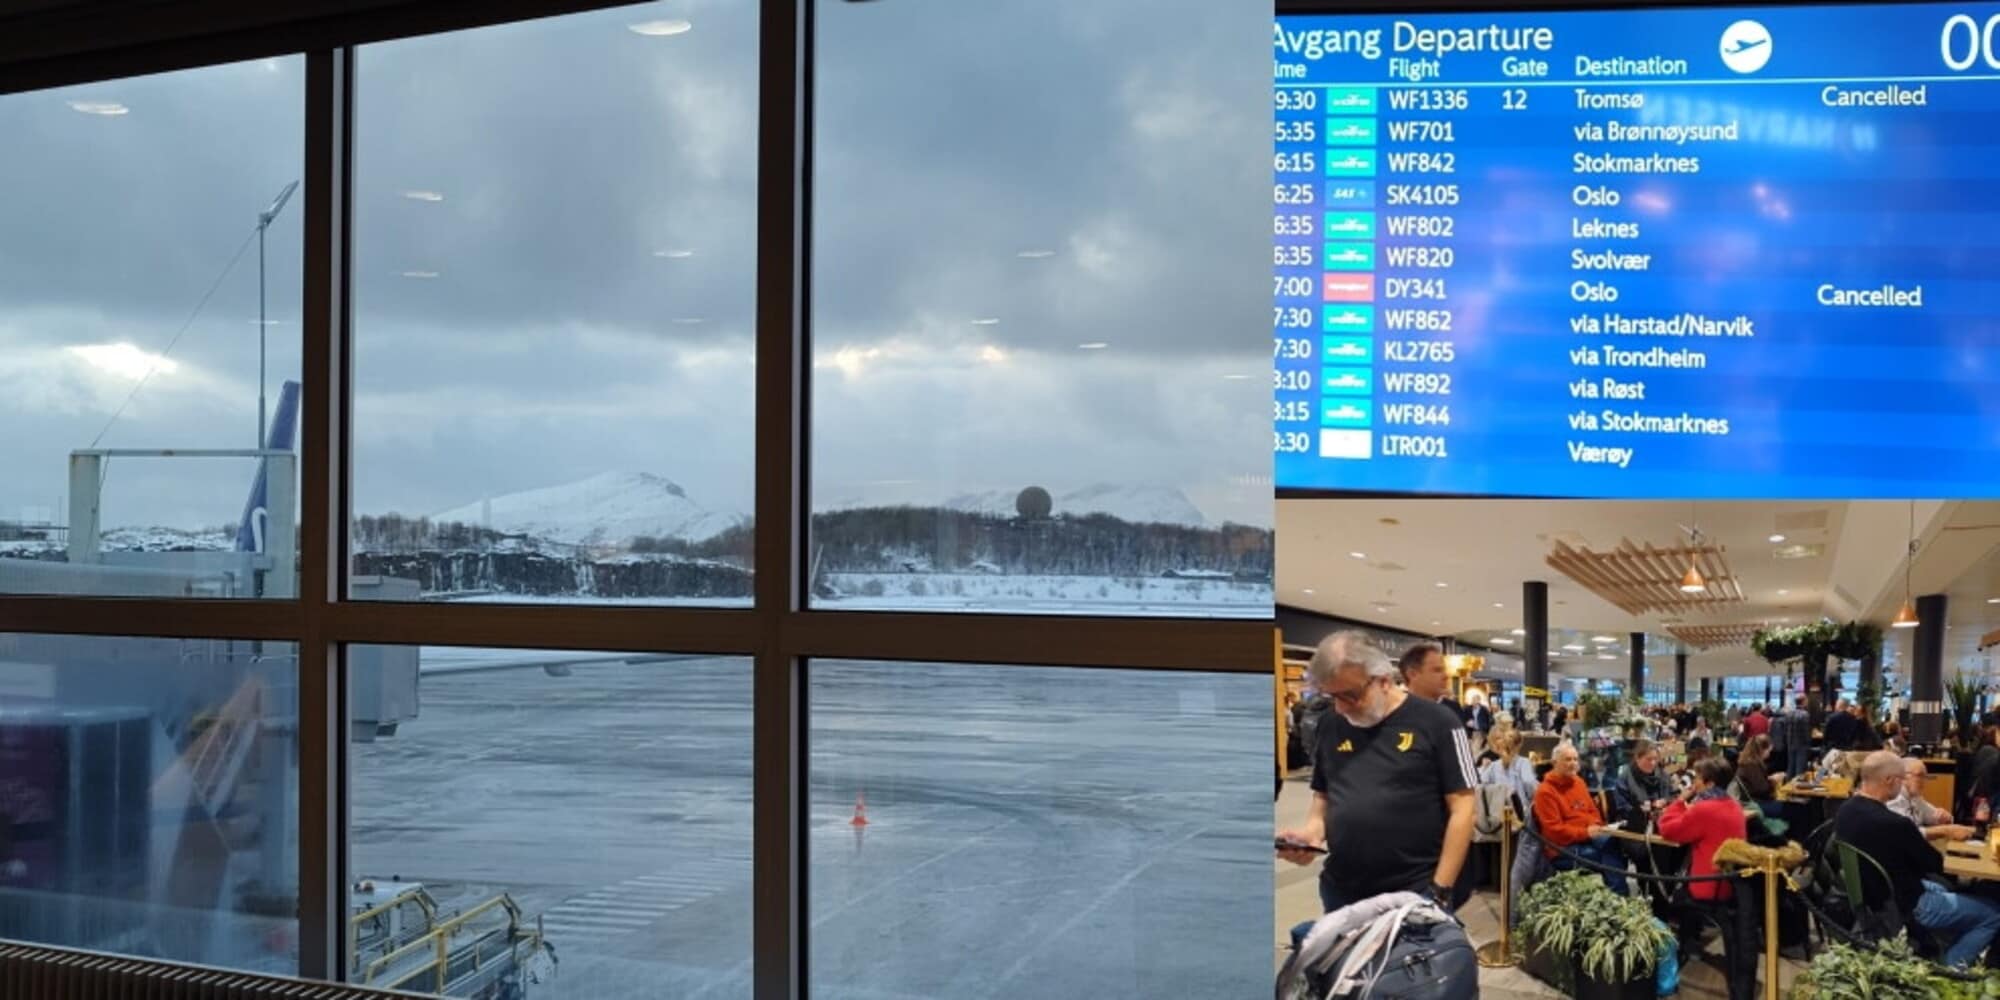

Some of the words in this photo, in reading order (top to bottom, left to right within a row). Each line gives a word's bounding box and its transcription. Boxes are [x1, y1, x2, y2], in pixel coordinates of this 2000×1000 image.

[1274, 22, 1381, 60] Avgang
[1393, 21, 1553, 56] Departure
[1389, 57, 1440, 82] Flight
[1502, 56, 1549, 77] Gate
[1575, 55, 1687, 76] Destination
[1274, 90, 1316, 110] 9:30
[1389, 89, 1468, 110] WF1336
[1502, 89, 1527, 110] 12
[1575, 88, 1644, 110] Tromsø
[1821, 85, 1927, 107] Cancelled
[1274, 121, 1316, 142] 5:35
[1388, 121, 1455, 142] WF701
[1574, 122, 1604, 141] via
[1608, 120, 1738, 144] Brønnøysund
[1388, 152, 1455, 173] WF842
[1573, 152, 1700, 173] Stokmarknes
[1387, 185, 1459, 205] SK4105
[1572, 185, 1621, 206] Oslo
[1387, 216, 1453, 237] WF802
[1572, 217, 1639, 239] Leknes
[1386, 247, 1453, 268] WF820
[1571, 248, 1651, 270] Svolvær
[1385, 278, 1447, 300] DY341
[1570, 280, 1618, 302] Oslo
[1817, 284, 1922, 306] Cancelled
[1385, 309, 1452, 331] WF862
[1570, 314, 1601, 334] via
[1604, 313, 1754, 337] Harstad/Narvik
[1384, 340, 1455, 362] KL2765
[1570, 346, 1600, 366] via
[1603, 345, 1706, 368] Trondheim
[1384, 373, 1451, 395] WF892
[1569, 378, 1599, 398] via
[1603, 377, 1645, 399] Røst
[1383, 404, 1450, 425] WF844
[1568, 410, 1599, 431] via
[1601, 409, 1730, 435] Stokmarknes
[1382, 435, 1447, 458] LTR001
[1568, 441, 1633, 468] Værøy
